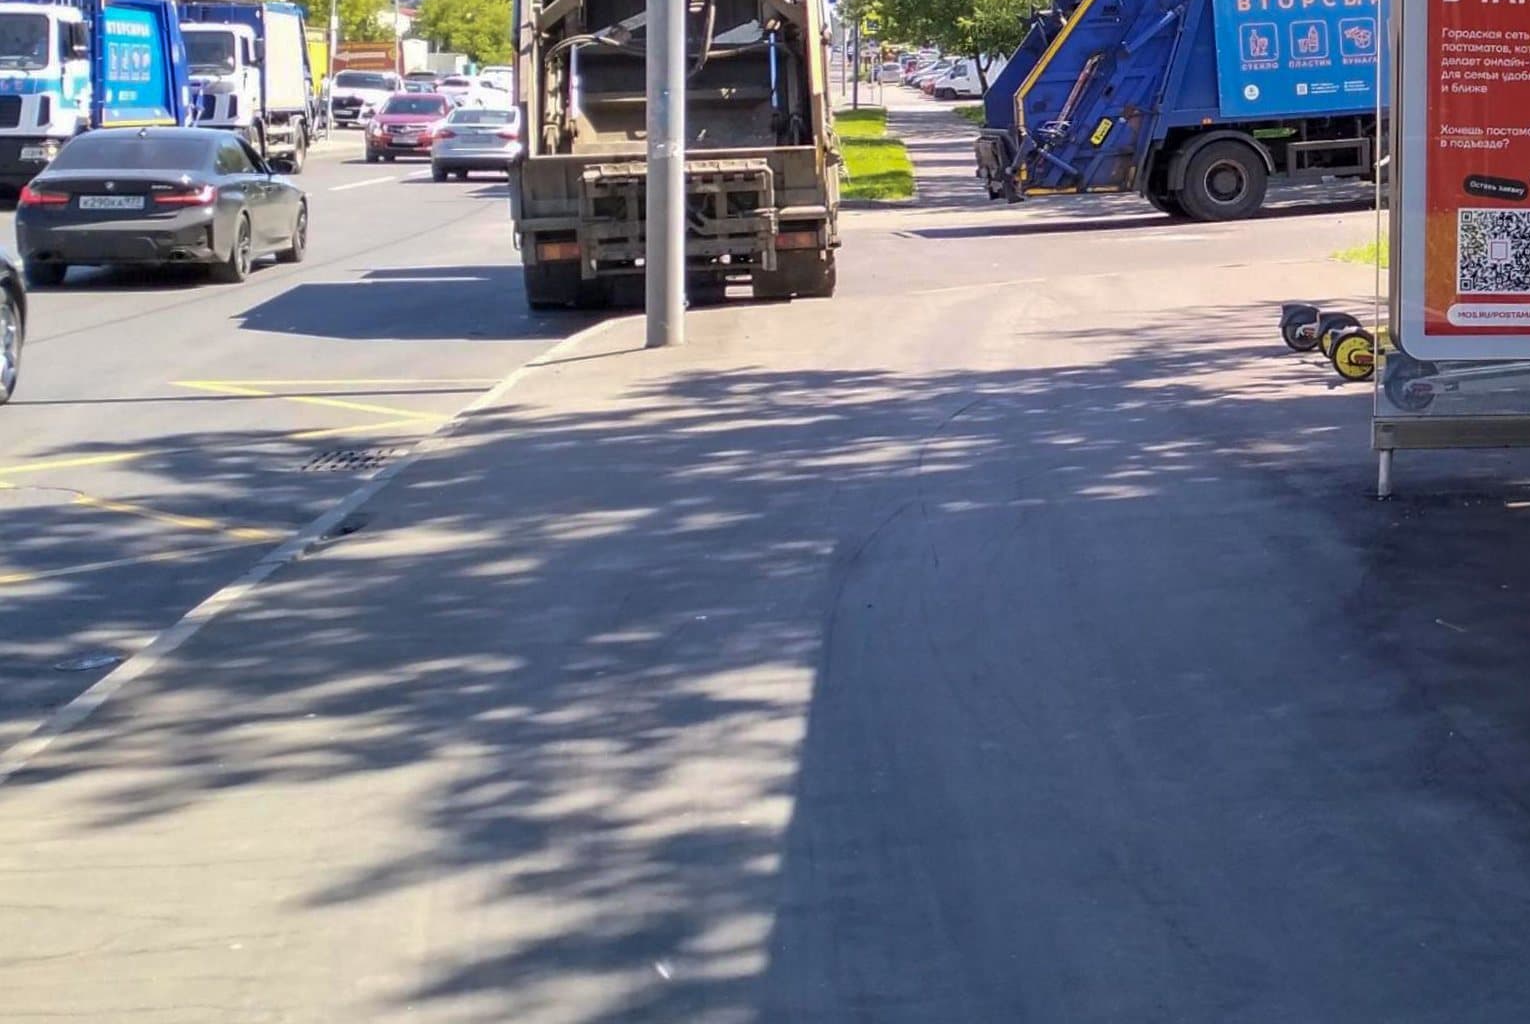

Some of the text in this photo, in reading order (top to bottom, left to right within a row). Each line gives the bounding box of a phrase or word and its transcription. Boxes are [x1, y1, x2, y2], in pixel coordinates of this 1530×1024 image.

[1441, 27, 1530, 41] Городская сеть
[1289, 59, 1332, 68] ПЛАСТИК
[1441, 57, 1481, 67] делает
[1441, 71, 1461, 80] для
[1464, 72, 1499, 81] семьи
[1441, 82, 1488, 93] и ближе
[1440, 124, 1483, 135] Хочешь
[1440, 138, 1510, 149] в подъезде?
